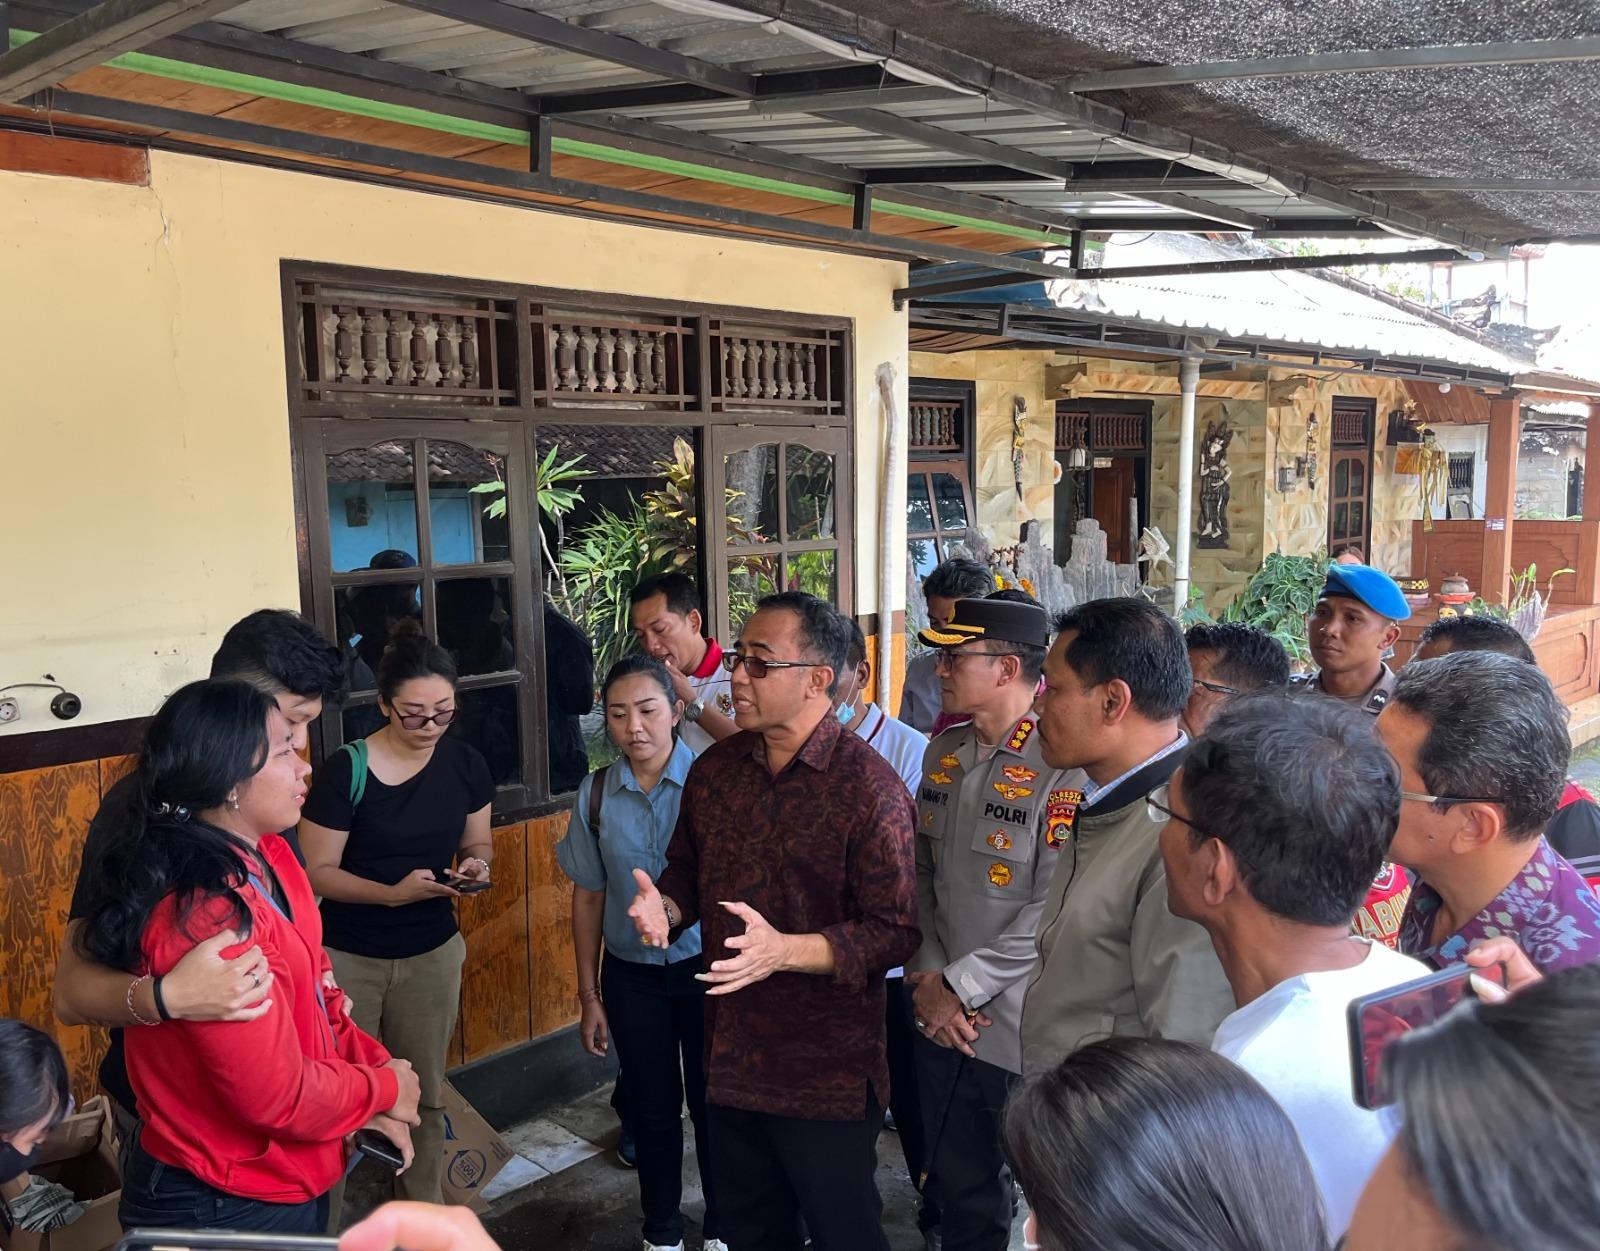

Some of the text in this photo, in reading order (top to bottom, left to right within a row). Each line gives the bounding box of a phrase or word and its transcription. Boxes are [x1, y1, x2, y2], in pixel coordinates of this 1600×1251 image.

[1049, 791, 1082, 801] OLRESTA
[984, 802, 1027, 825] POLRI
[1052, 808, 1075, 816] BALI
